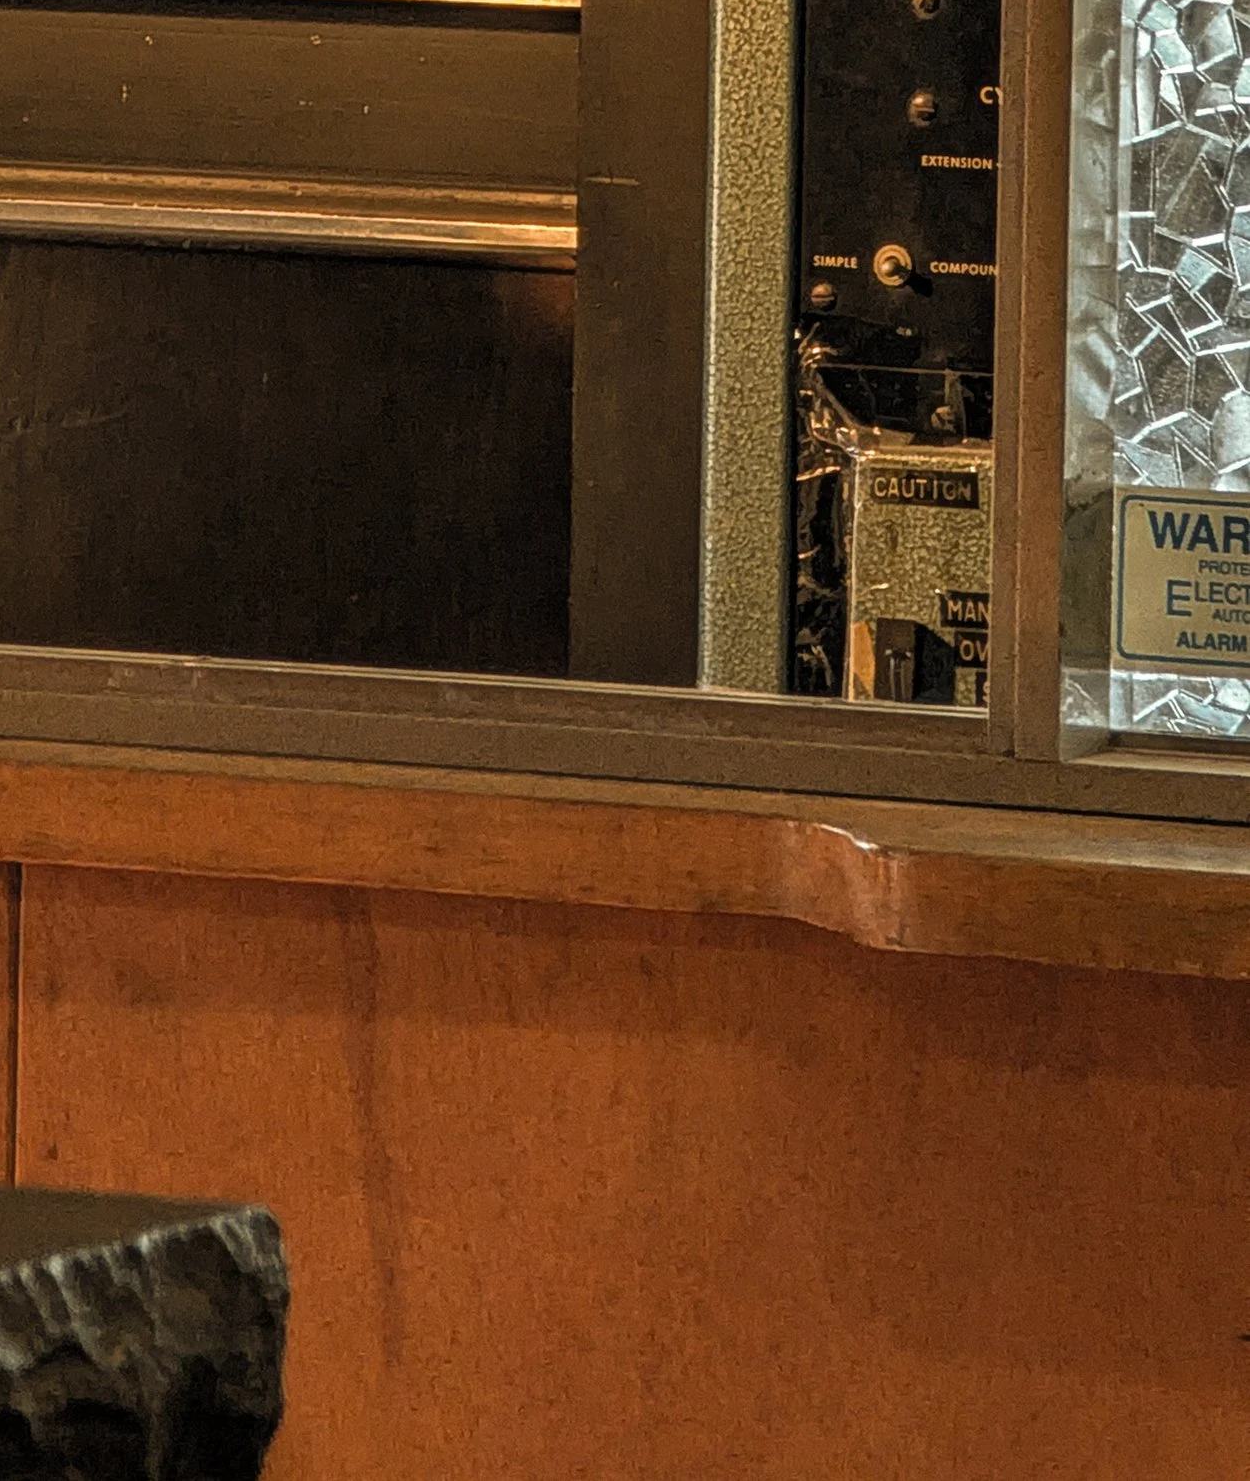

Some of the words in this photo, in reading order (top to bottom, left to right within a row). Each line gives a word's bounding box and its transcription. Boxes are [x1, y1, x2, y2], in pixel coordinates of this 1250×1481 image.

[921, 155, 993, 170] EXTENSION
[813, 255, 858, 269] SIMPLE
[873, 476, 972, 501] CAUTION
[1147, 510, 1250, 555] WAR
[1176, 631, 1248, 652] ALARM
